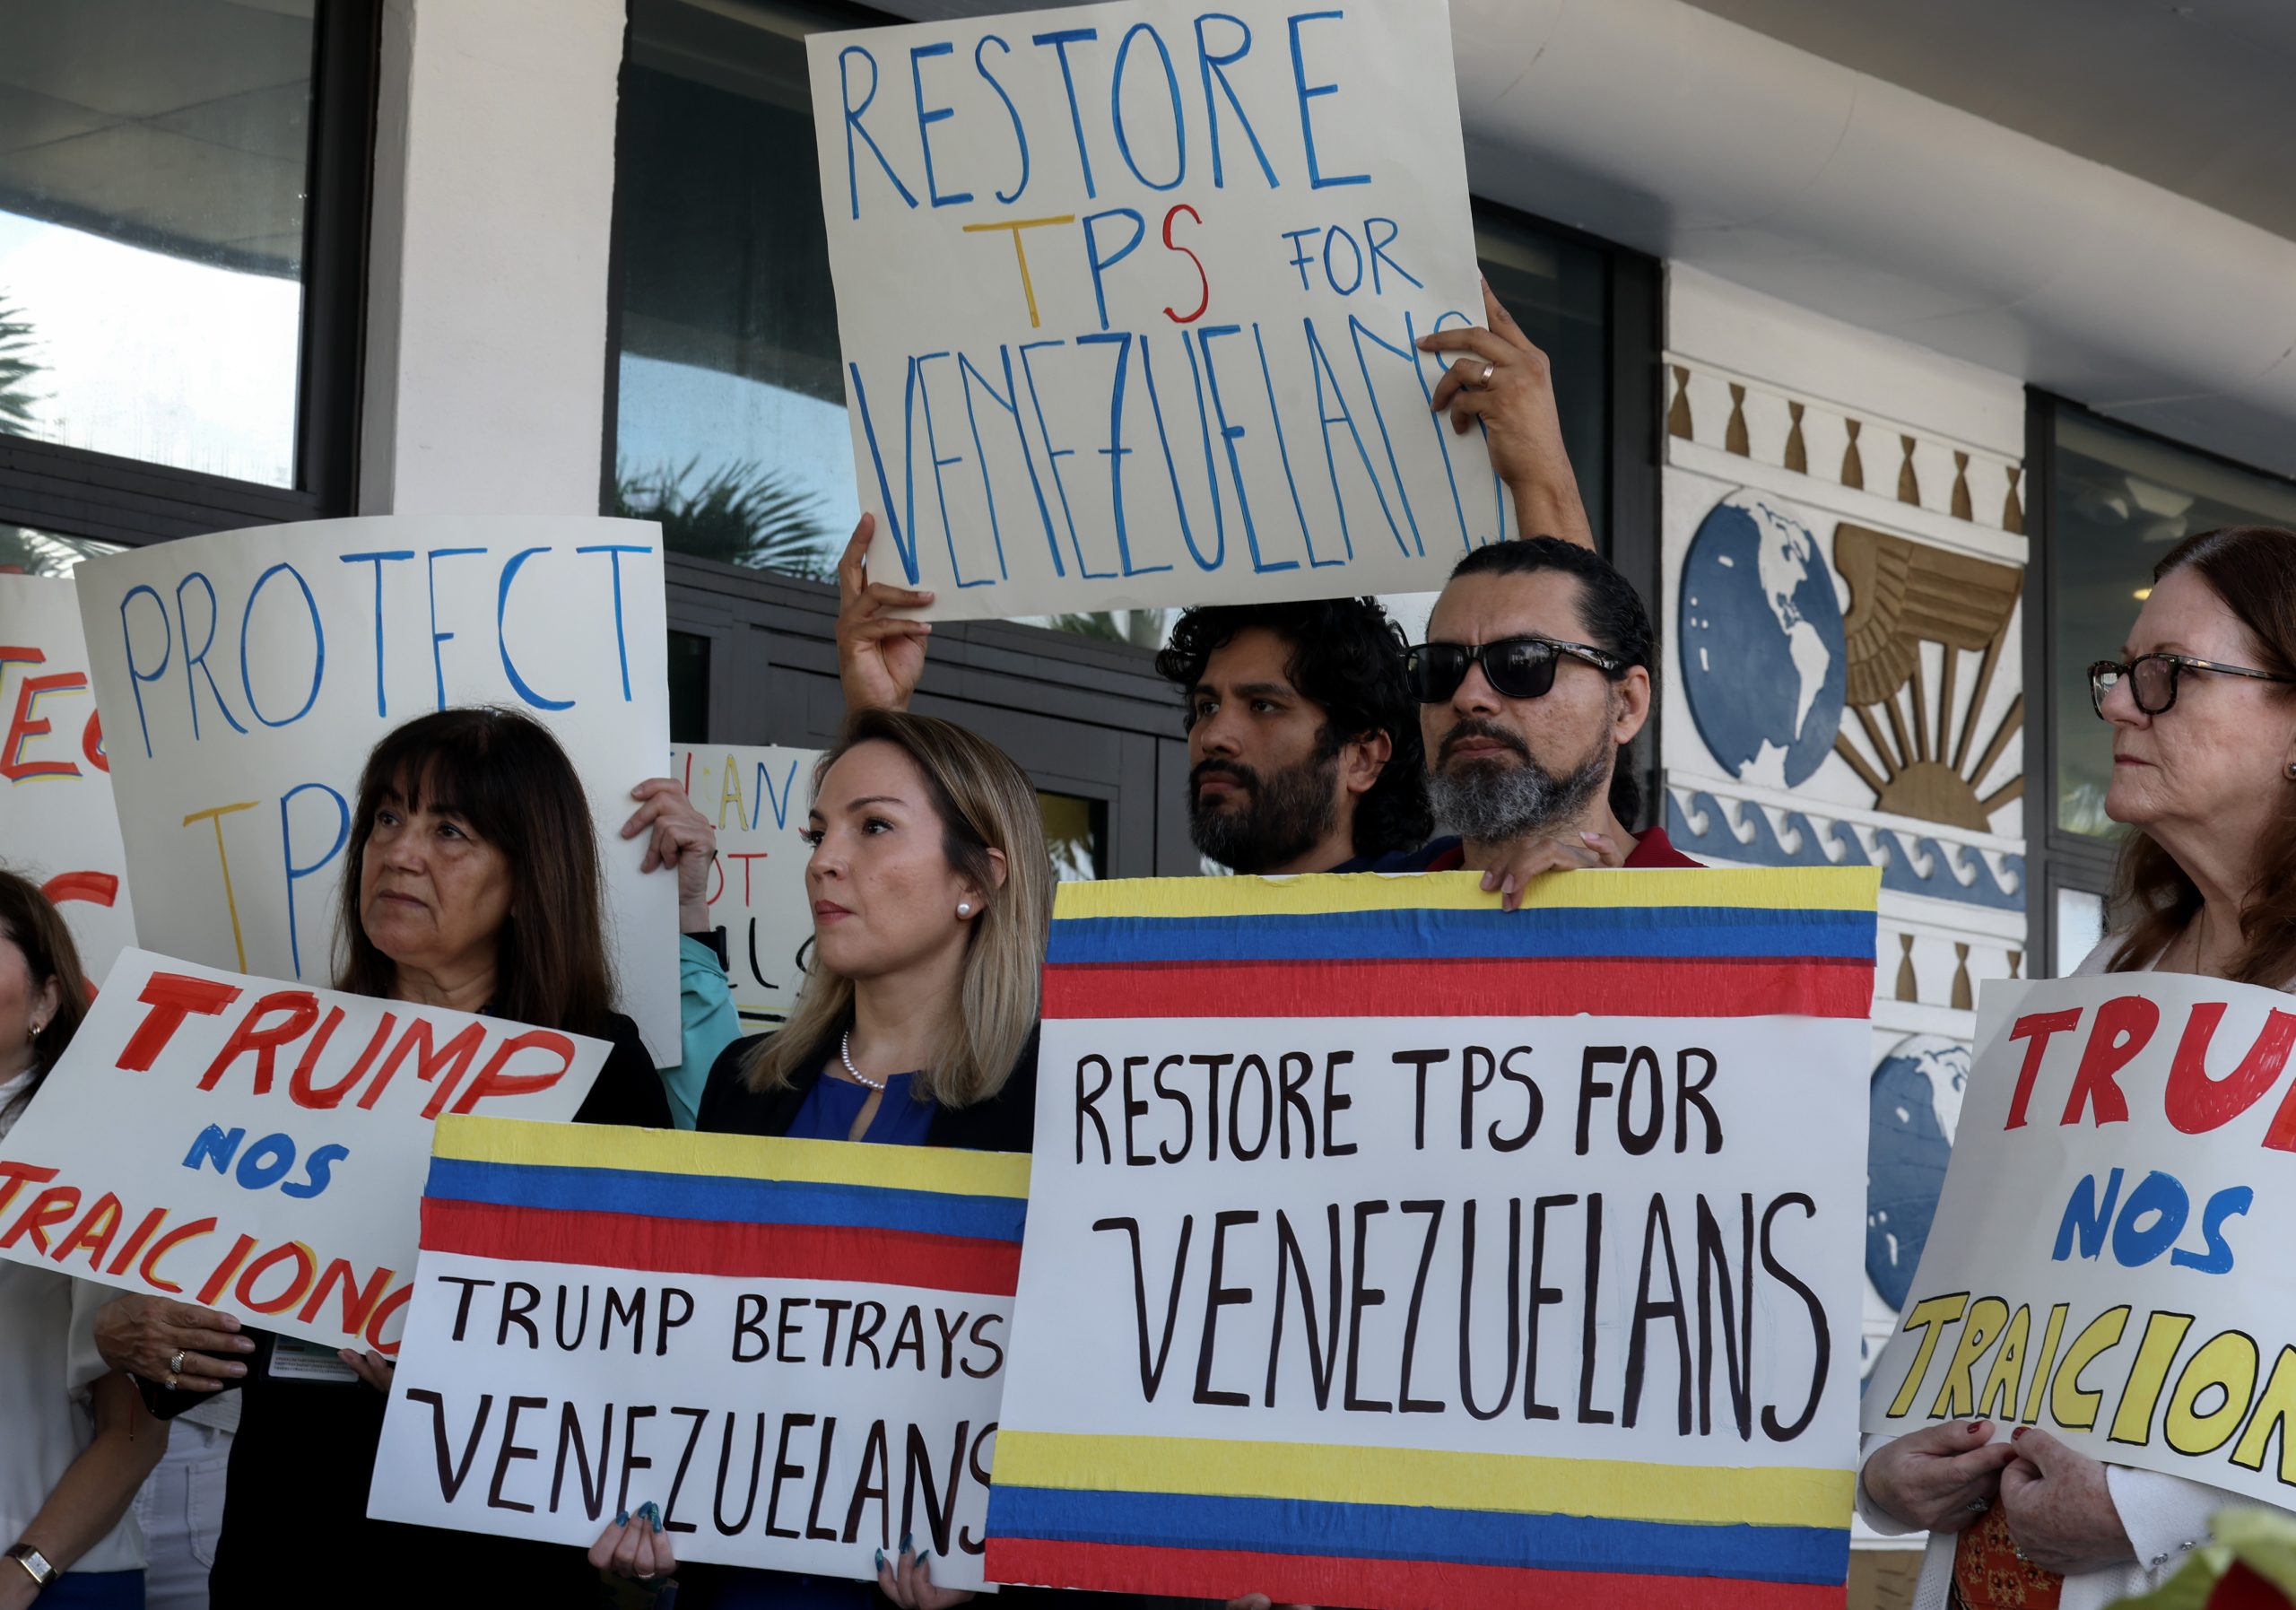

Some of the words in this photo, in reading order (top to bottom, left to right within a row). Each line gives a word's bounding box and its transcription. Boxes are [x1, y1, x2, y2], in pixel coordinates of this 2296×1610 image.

[839, 11, 1372, 221] RESTORE
[962, 204, 1210, 331] TPS
[1281, 217, 1423, 296] FOR
[120, 544, 655, 759] PROTECT
[183, 782, 352, 979] TP
[115, 970, 576, 1120] TRUMP
[1075, 1051, 1358, 1166] RESTORE
[1391, 1045, 1544, 1153] TPS
[1575, 1045, 1724, 1156] FOR
[2003, 995, 2296, 1153] TRU
[181, 1123, 351, 1199] NOS
[2051, 1167, 2255, 1275] NOS
[438, 1275, 695, 1357] TRUMP
[731, 1292, 1004, 1379] BETRAYS
[1091, 1192, 1831, 1442] VENEZUELANS
